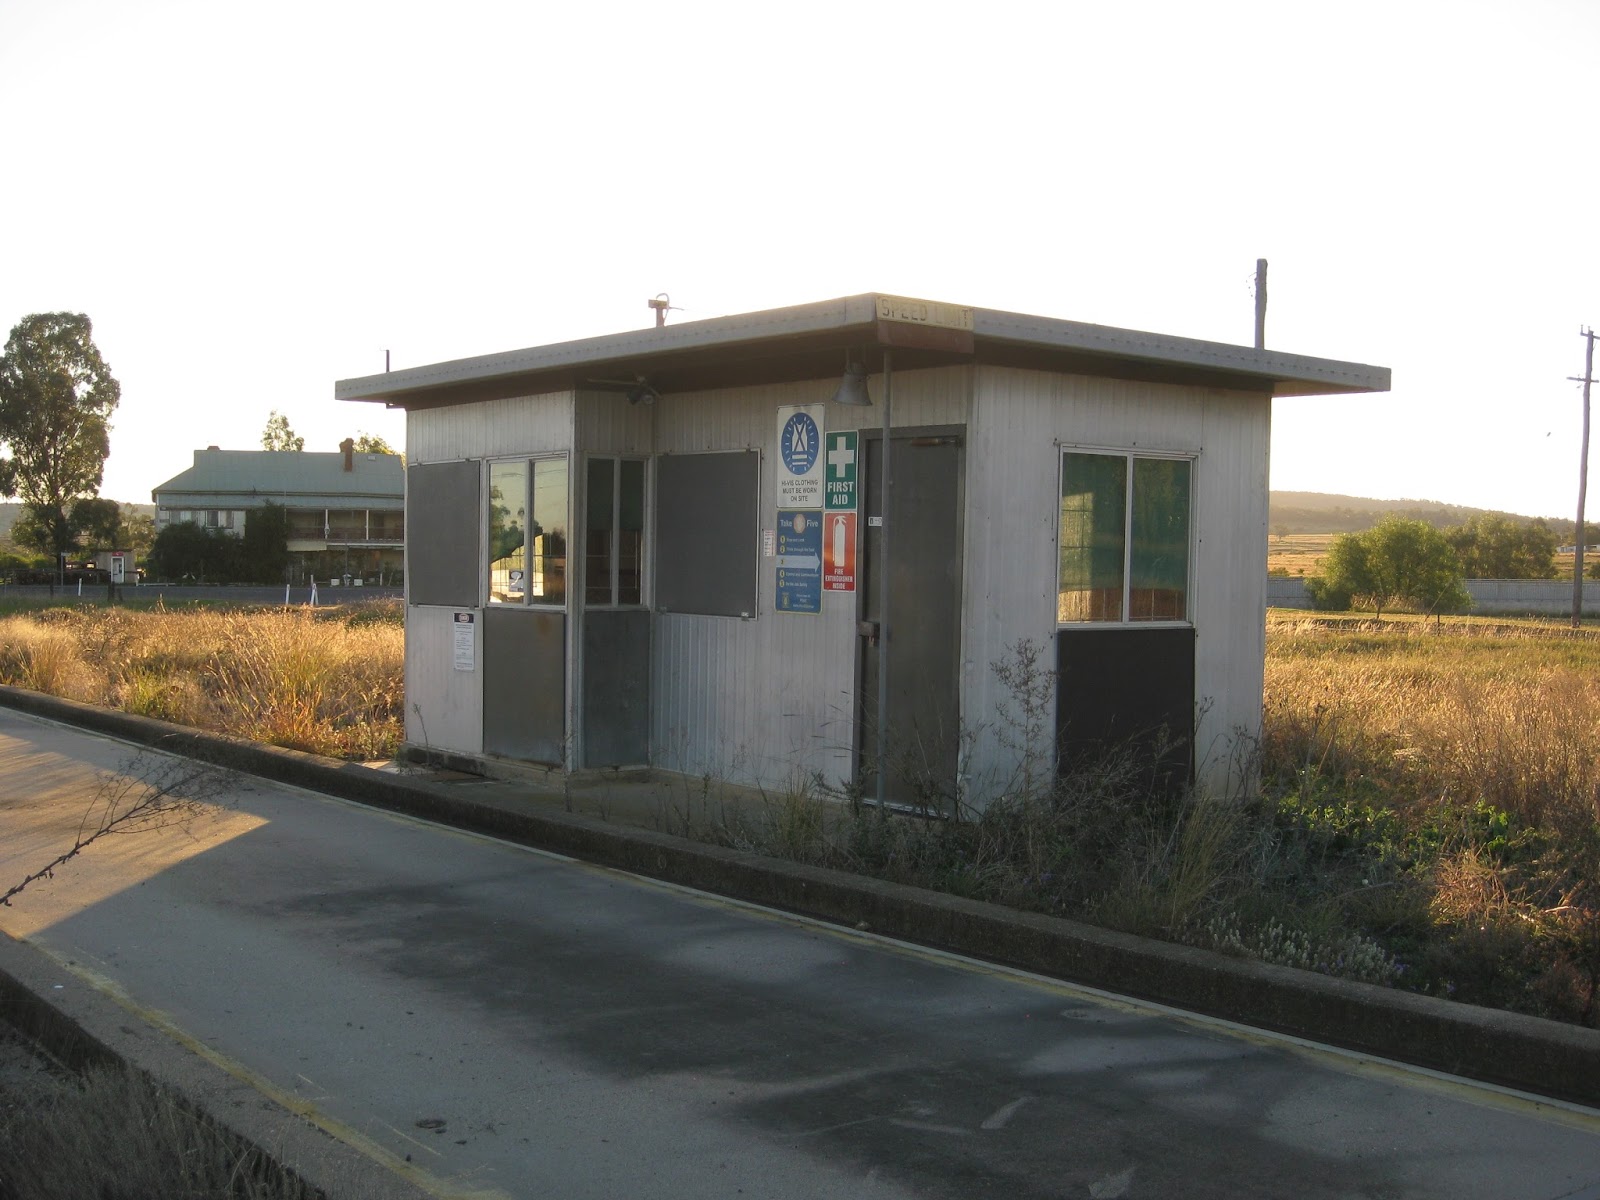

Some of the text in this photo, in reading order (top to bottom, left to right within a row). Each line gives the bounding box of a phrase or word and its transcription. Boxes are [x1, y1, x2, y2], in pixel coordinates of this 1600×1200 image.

[881, 298, 969, 328] SPEED LIT
[827, 481, 854, 493] FIRST
[832, 494, 848, 505] AID
[832, 582, 846, 590] INSIDE
